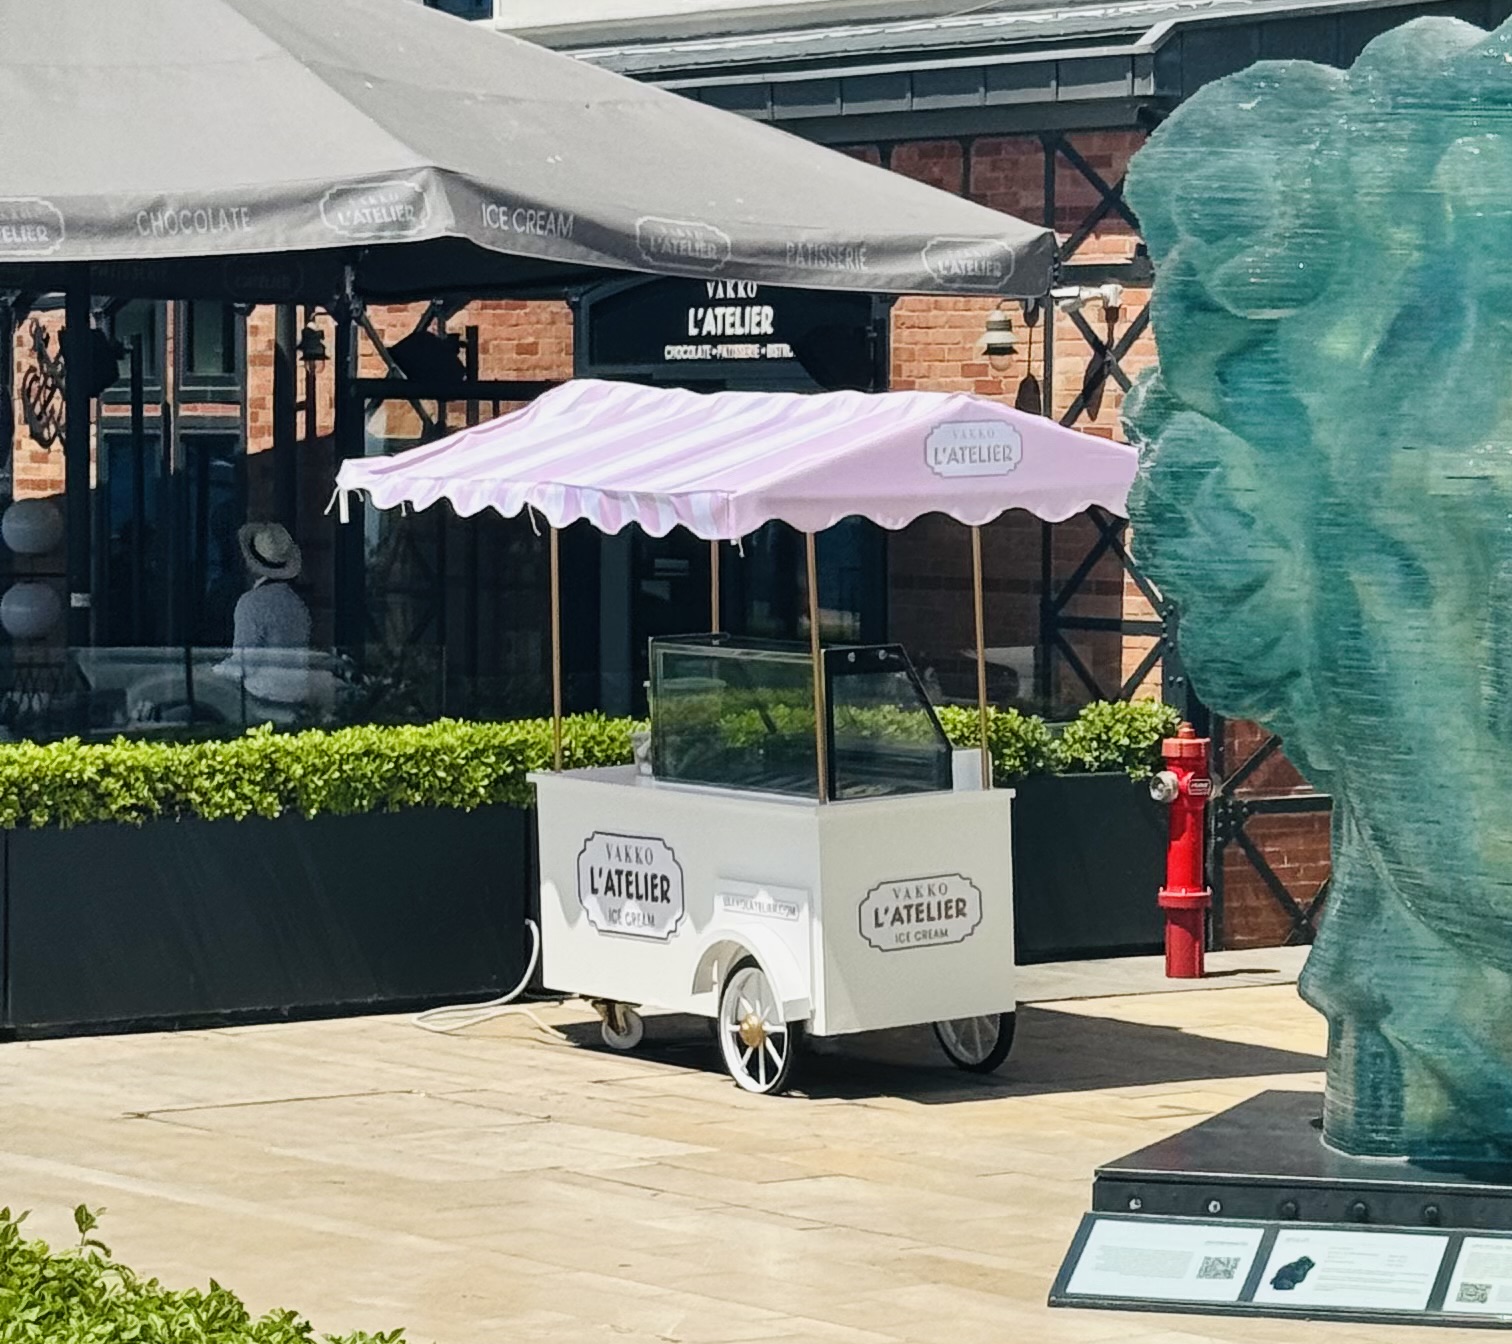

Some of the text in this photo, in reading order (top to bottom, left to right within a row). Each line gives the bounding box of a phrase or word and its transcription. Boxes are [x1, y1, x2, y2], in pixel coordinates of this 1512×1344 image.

[136, 207, 250, 236] CHOCOLATE
[481, 203, 574, 237] ICE CREAM
[786, 240, 868, 270] PATISSERIE
[706, 280, 757, 299] VAKKO
[688, 305, 774, 336] L'ATELIER
[664, 345, 712, 360] CHOCOLATE
[953, 428, 995, 439] VAKKO
[934, 444, 1013, 465] L'ATELIER
[605, 843, 654, 865] VAKKO
[590, 866, 671, 904] L'ATELIER
[892, 882, 948, 900] VAKKO
[607, 907, 656, 928] ICE CREAM
[874, 897, 967, 928] L'ATELIER
[895, 928, 949, 944] ICE CREAM
